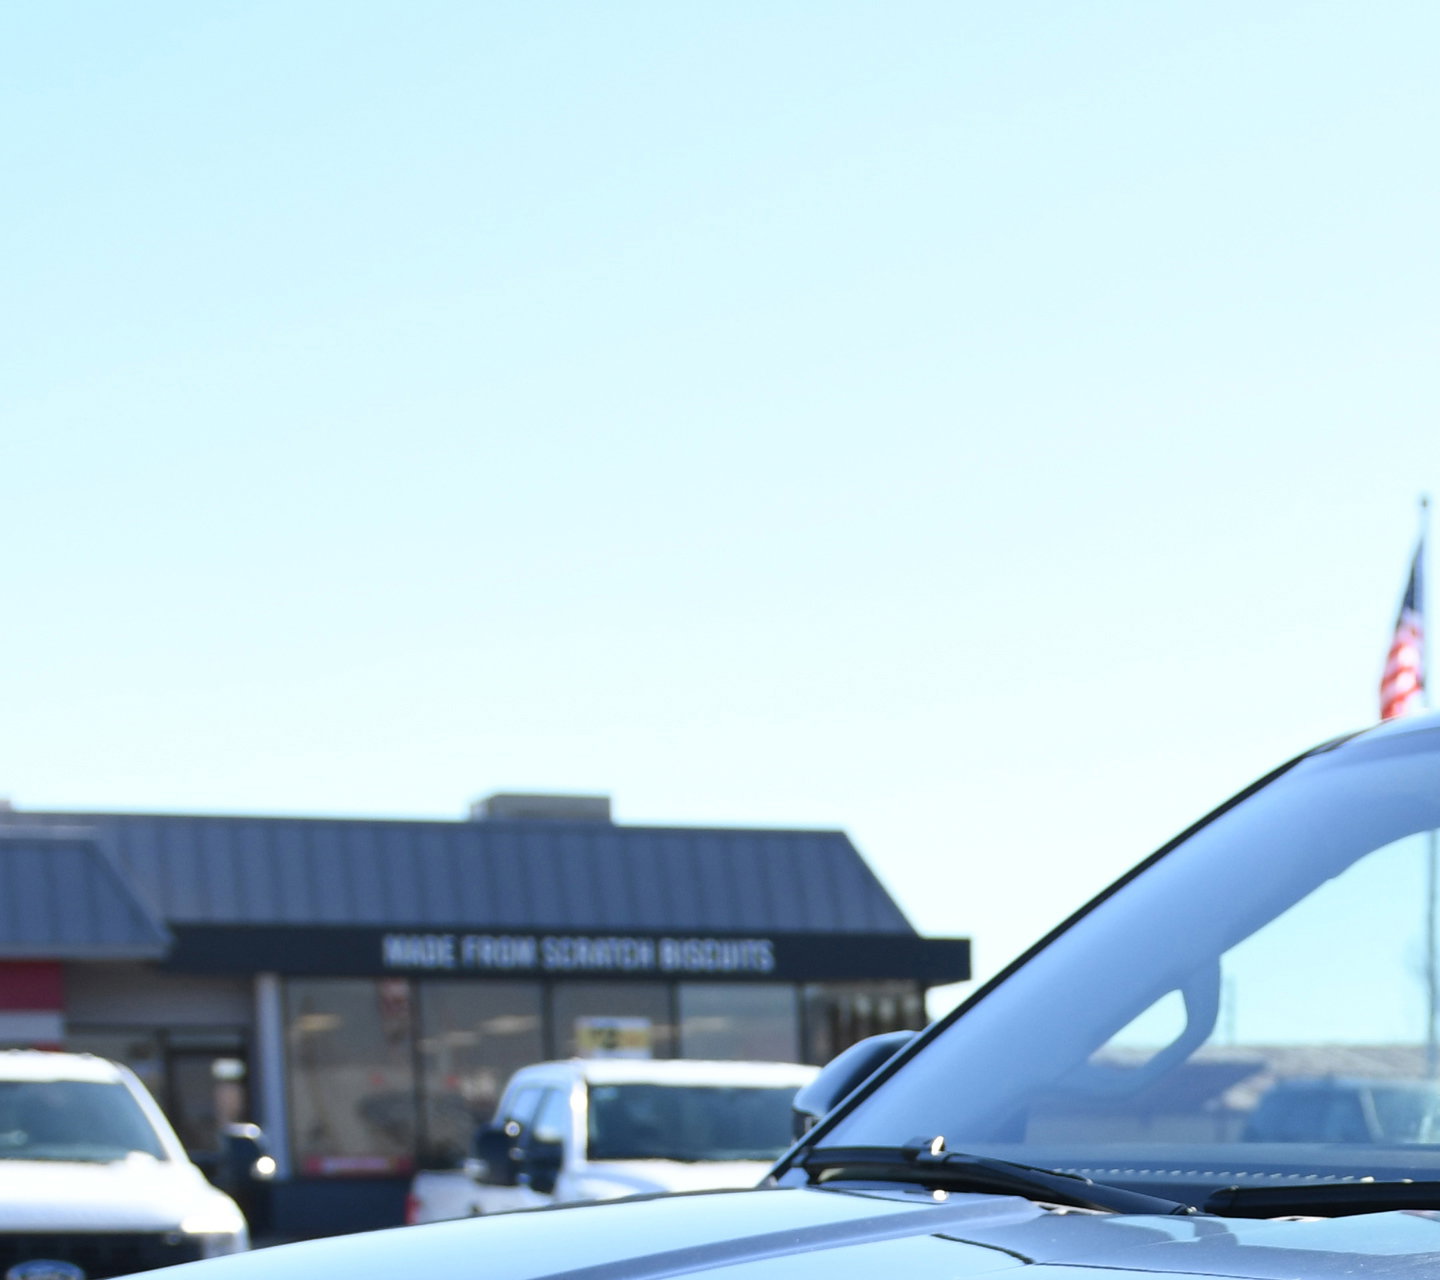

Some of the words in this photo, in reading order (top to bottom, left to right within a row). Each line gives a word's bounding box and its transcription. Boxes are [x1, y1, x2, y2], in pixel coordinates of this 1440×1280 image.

[382, 933, 457, 967] MADE
[462, 934, 537, 969] FROM
[542, 936, 656, 971] SCRATCH
[660, 938, 776, 973] BISCUITS
